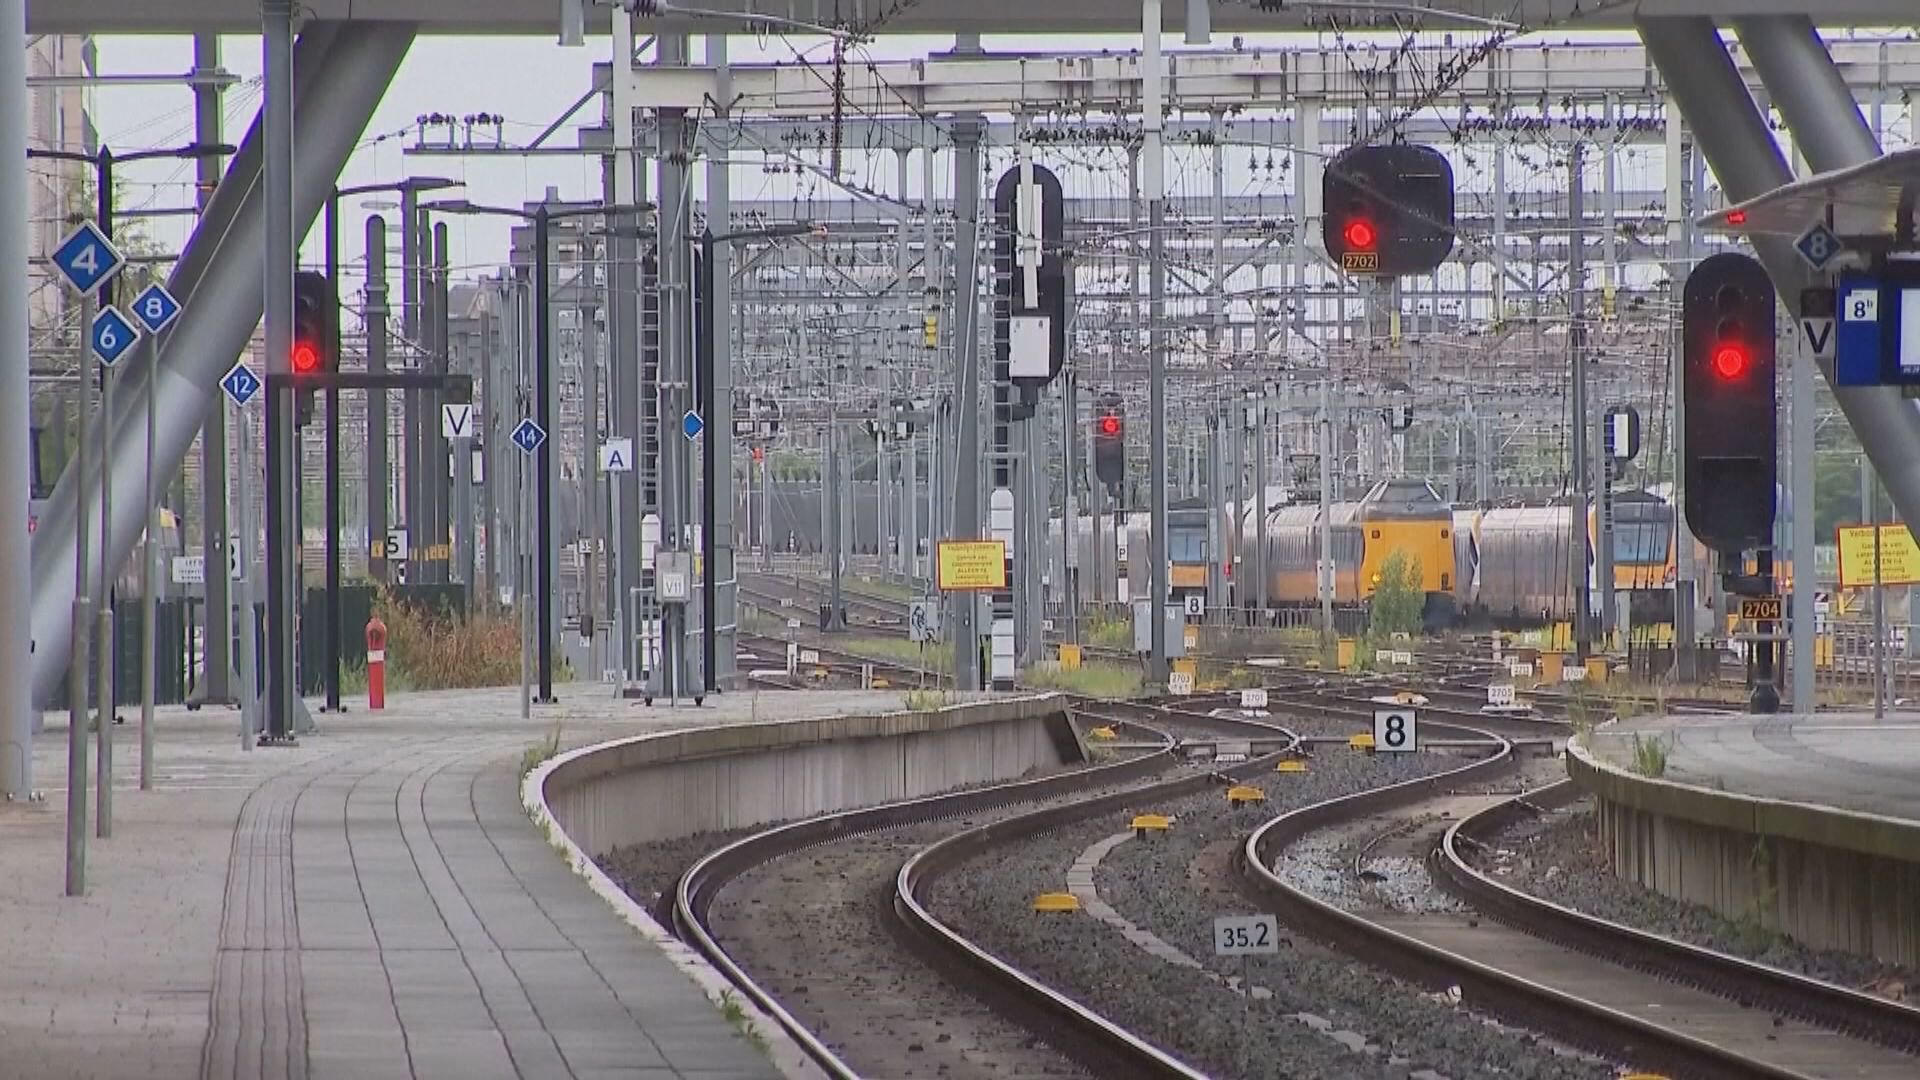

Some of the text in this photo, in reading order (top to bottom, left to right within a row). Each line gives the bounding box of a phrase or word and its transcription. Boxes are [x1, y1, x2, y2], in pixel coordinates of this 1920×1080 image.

[1811, 232, 1828, 257] 8
[71, 244, 98, 276] 4
[1345, 255, 1375, 268] 2702
[145, 298, 163, 318] 8
[100, 324, 117, 350] 6
[1804, 321, 1832, 354] V
[231, 376, 250, 396] 12
[446, 406, 468, 435] V
[520, 430, 536, 446] 14
[609, 450, 624, 467] A
[388, 536, 399, 554] 5
[1190, 598, 1200, 613] 8
[1744, 602, 1779, 618] 2704
[1384, 714, 1406, 747] 8
[1223, 921, 1270, 948] 35.2
